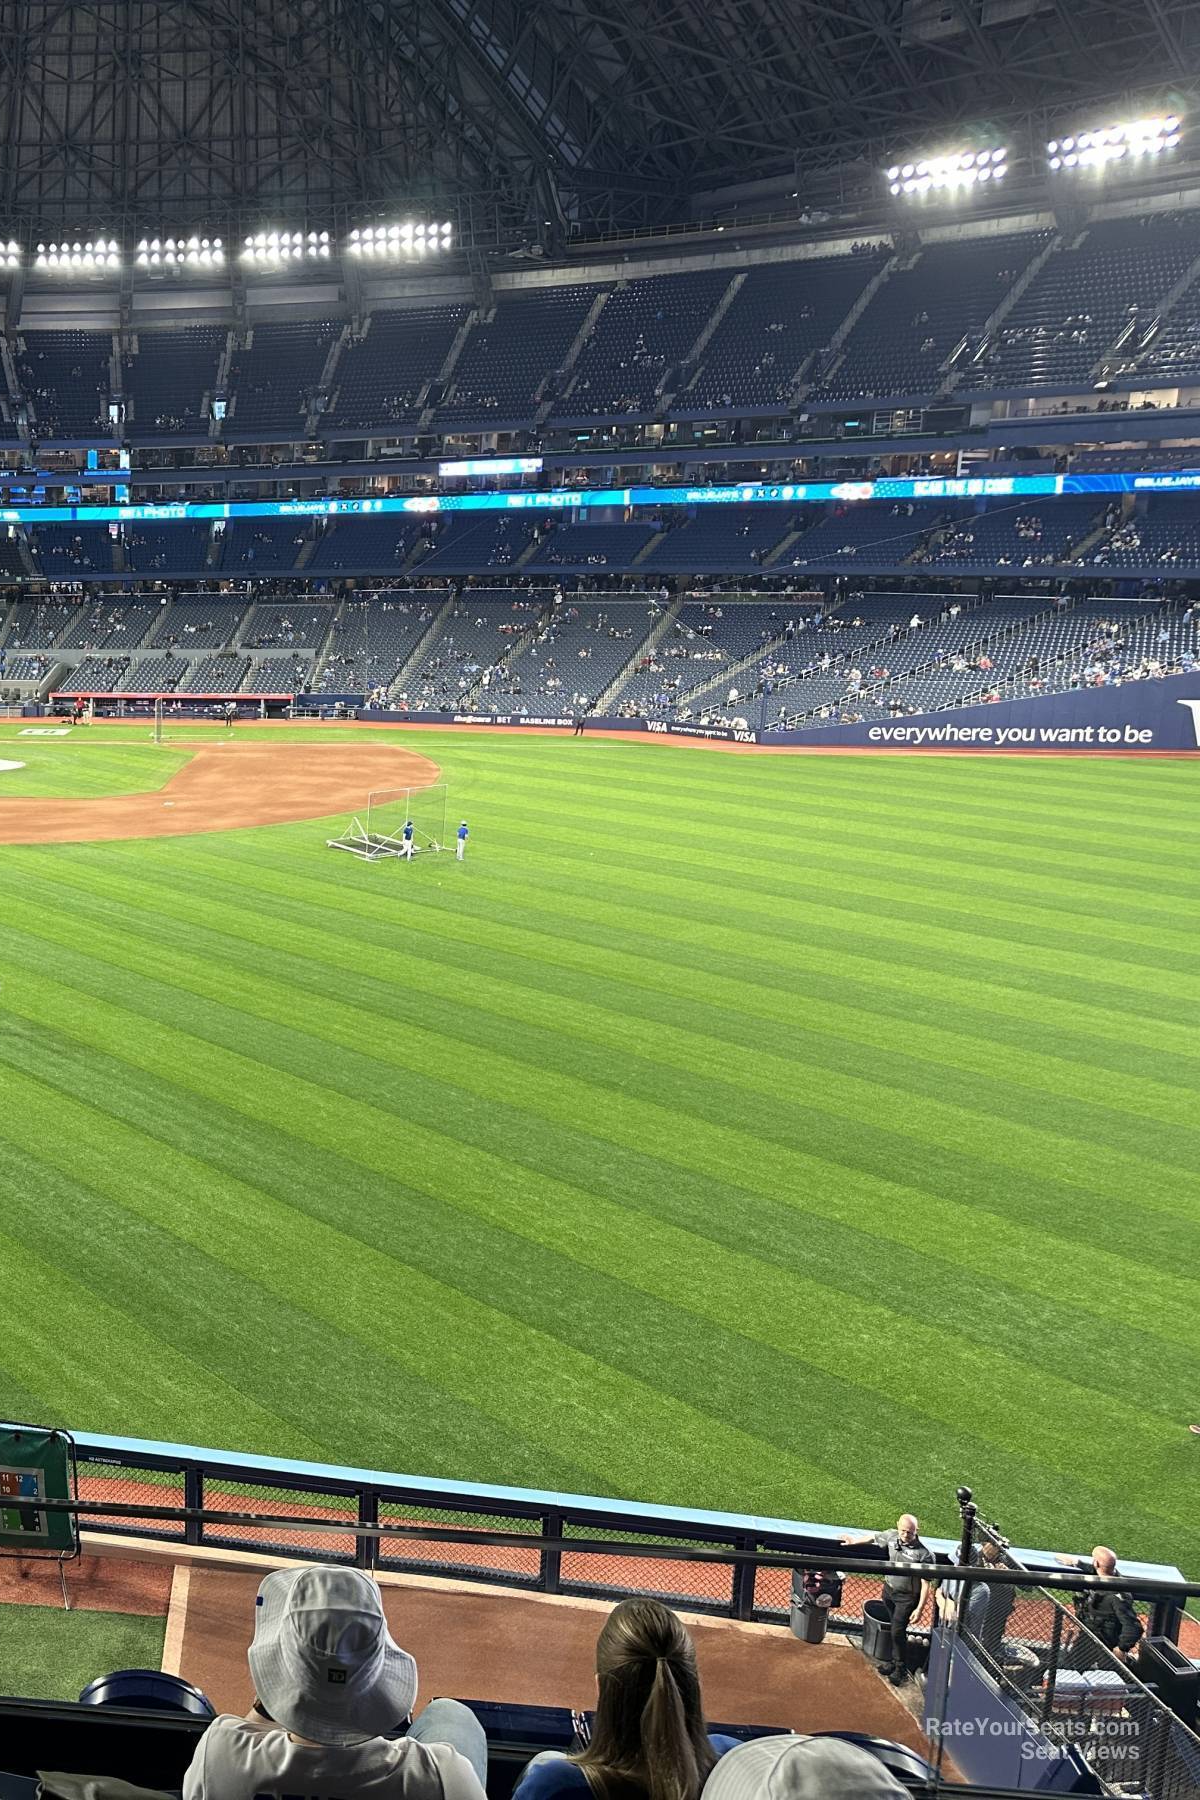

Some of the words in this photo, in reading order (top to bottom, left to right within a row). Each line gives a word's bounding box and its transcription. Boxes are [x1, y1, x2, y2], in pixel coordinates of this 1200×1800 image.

[536, 493, 581, 506] PHOTO
[144, 506, 186, 518] PHOTO
[520, 717, 556, 725] BASELINE
[646, 721, 667, 733] VISA
[733, 730, 757, 743] VISA
[868, 724, 993, 744] everywhere
[994, 727, 1036, 745] you
[1039, 726, 1094, 743] want
[1097, 726, 1121, 743] to
[1124, 724, 1153, 743] be
[2, 1474, 9, 1482] 11
[15, 1475, 23, 1483] 12
